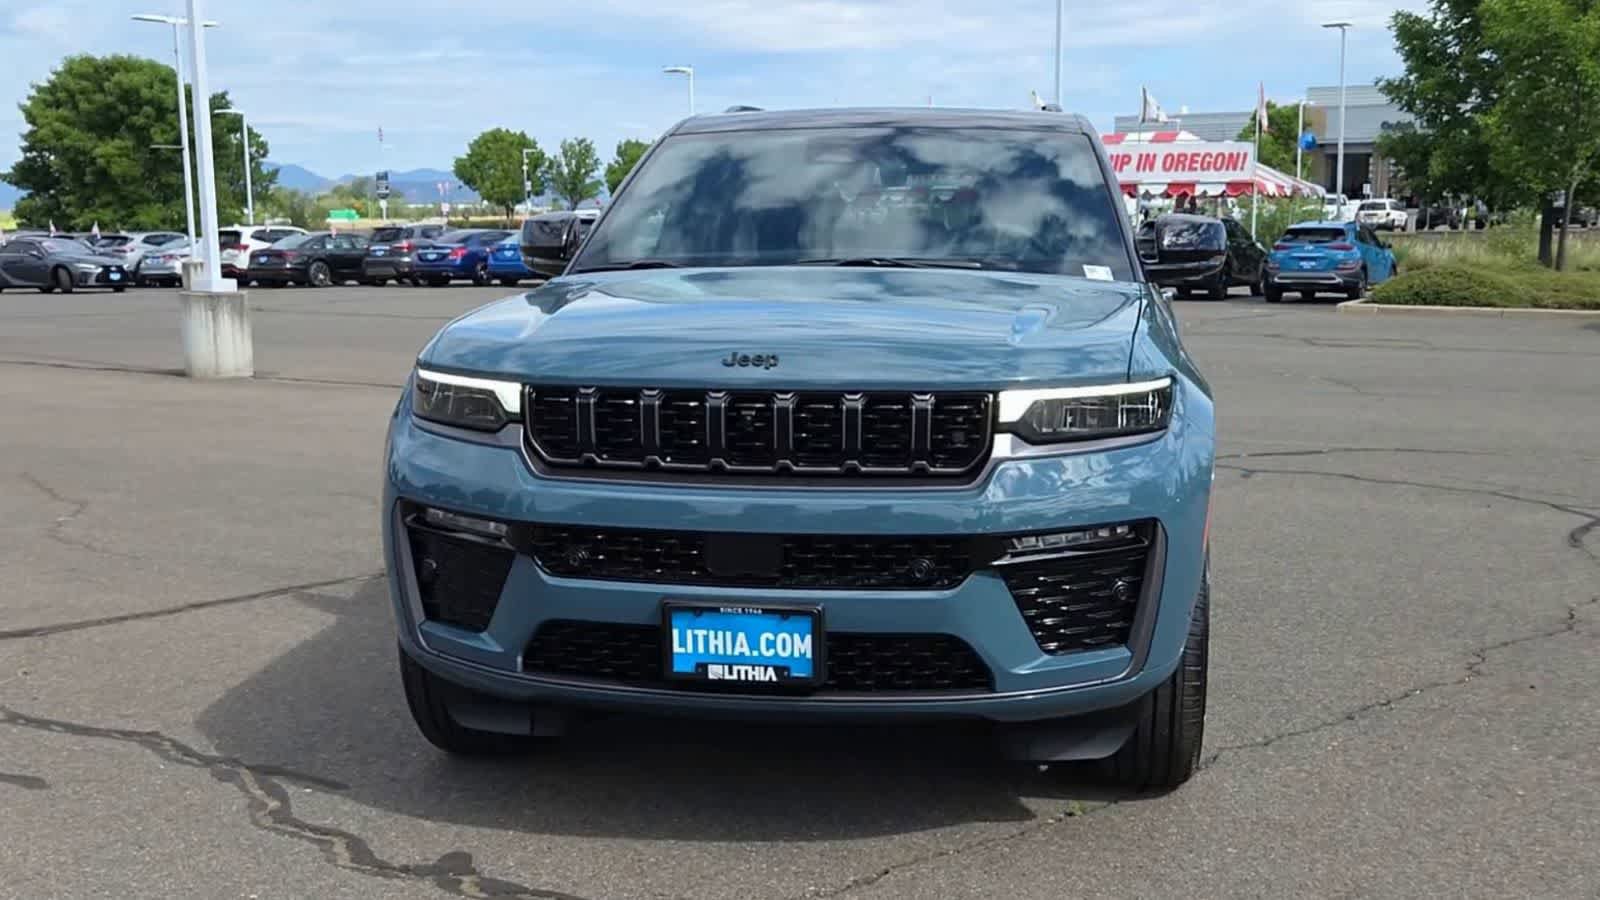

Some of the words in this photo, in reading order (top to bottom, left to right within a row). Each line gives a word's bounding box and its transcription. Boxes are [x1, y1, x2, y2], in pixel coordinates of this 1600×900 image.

[1136, 153, 1156, 172] IN
[1162, 152, 1249, 172] OREGON!
[721, 352, 778, 370] Jeep
[672, 628, 812, 658] LITHIA.COM
[723, 665, 777, 681] LITHIA
